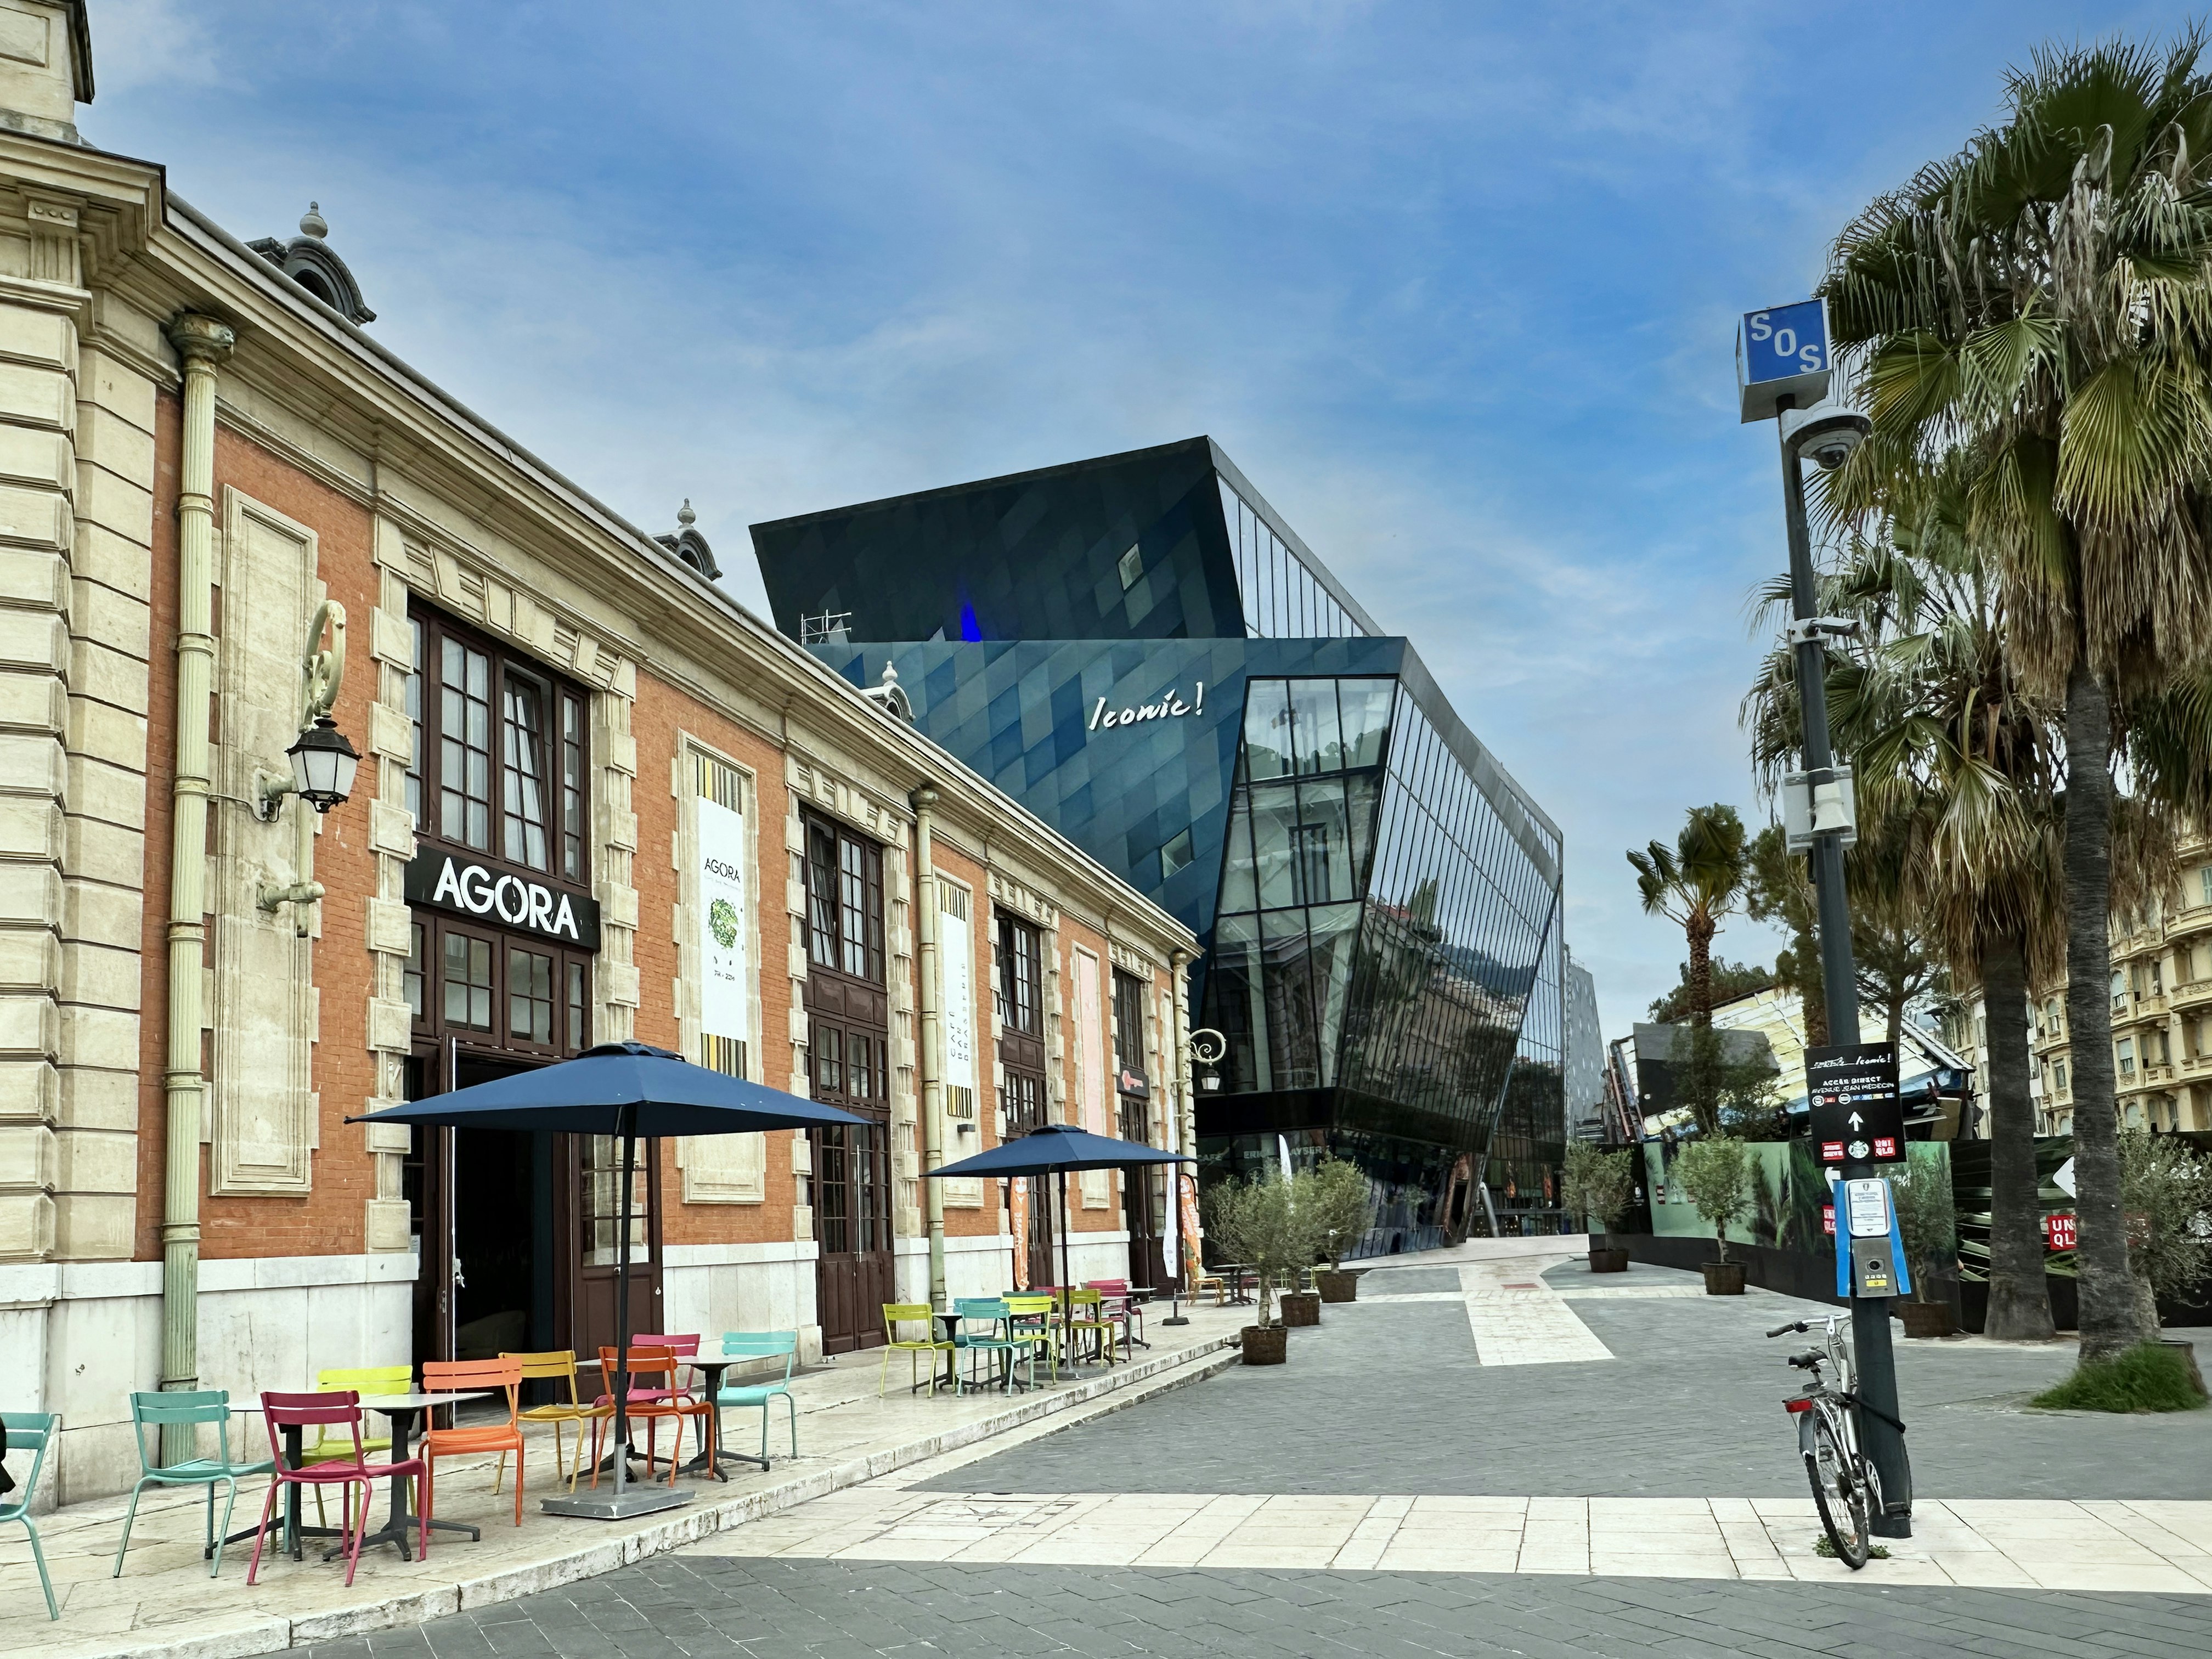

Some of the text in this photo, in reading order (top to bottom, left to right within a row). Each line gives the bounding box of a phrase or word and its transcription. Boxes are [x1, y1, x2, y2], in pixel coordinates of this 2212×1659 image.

[1750, 313, 1821, 373] SOS
[1088, 681, 1203, 731] Iconic!
[704, 857, 741, 883] AGORA
[433, 856, 579, 940] AGORA
